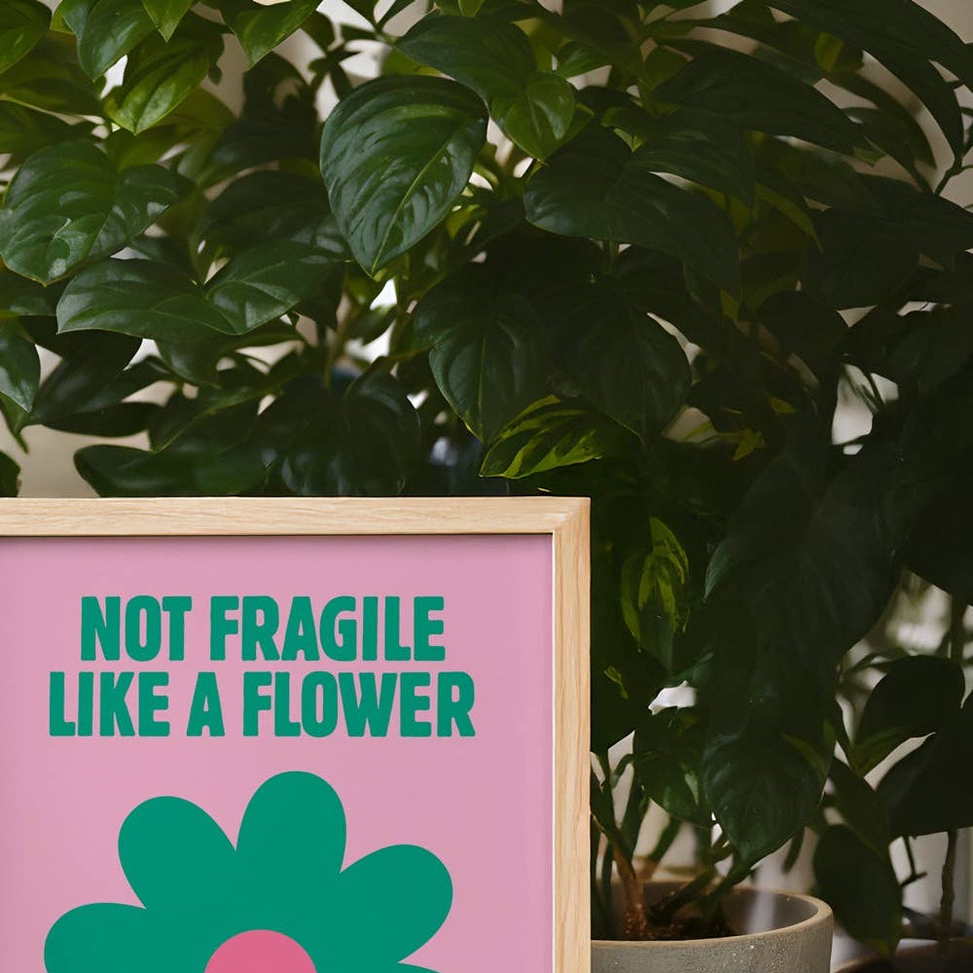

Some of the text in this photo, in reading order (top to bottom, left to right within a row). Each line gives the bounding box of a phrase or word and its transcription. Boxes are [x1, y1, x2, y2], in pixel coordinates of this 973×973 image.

[81, 595, 446, 662] NOT FRAGILE
[49, 671, 475, 738] LIKE A FLOWER
